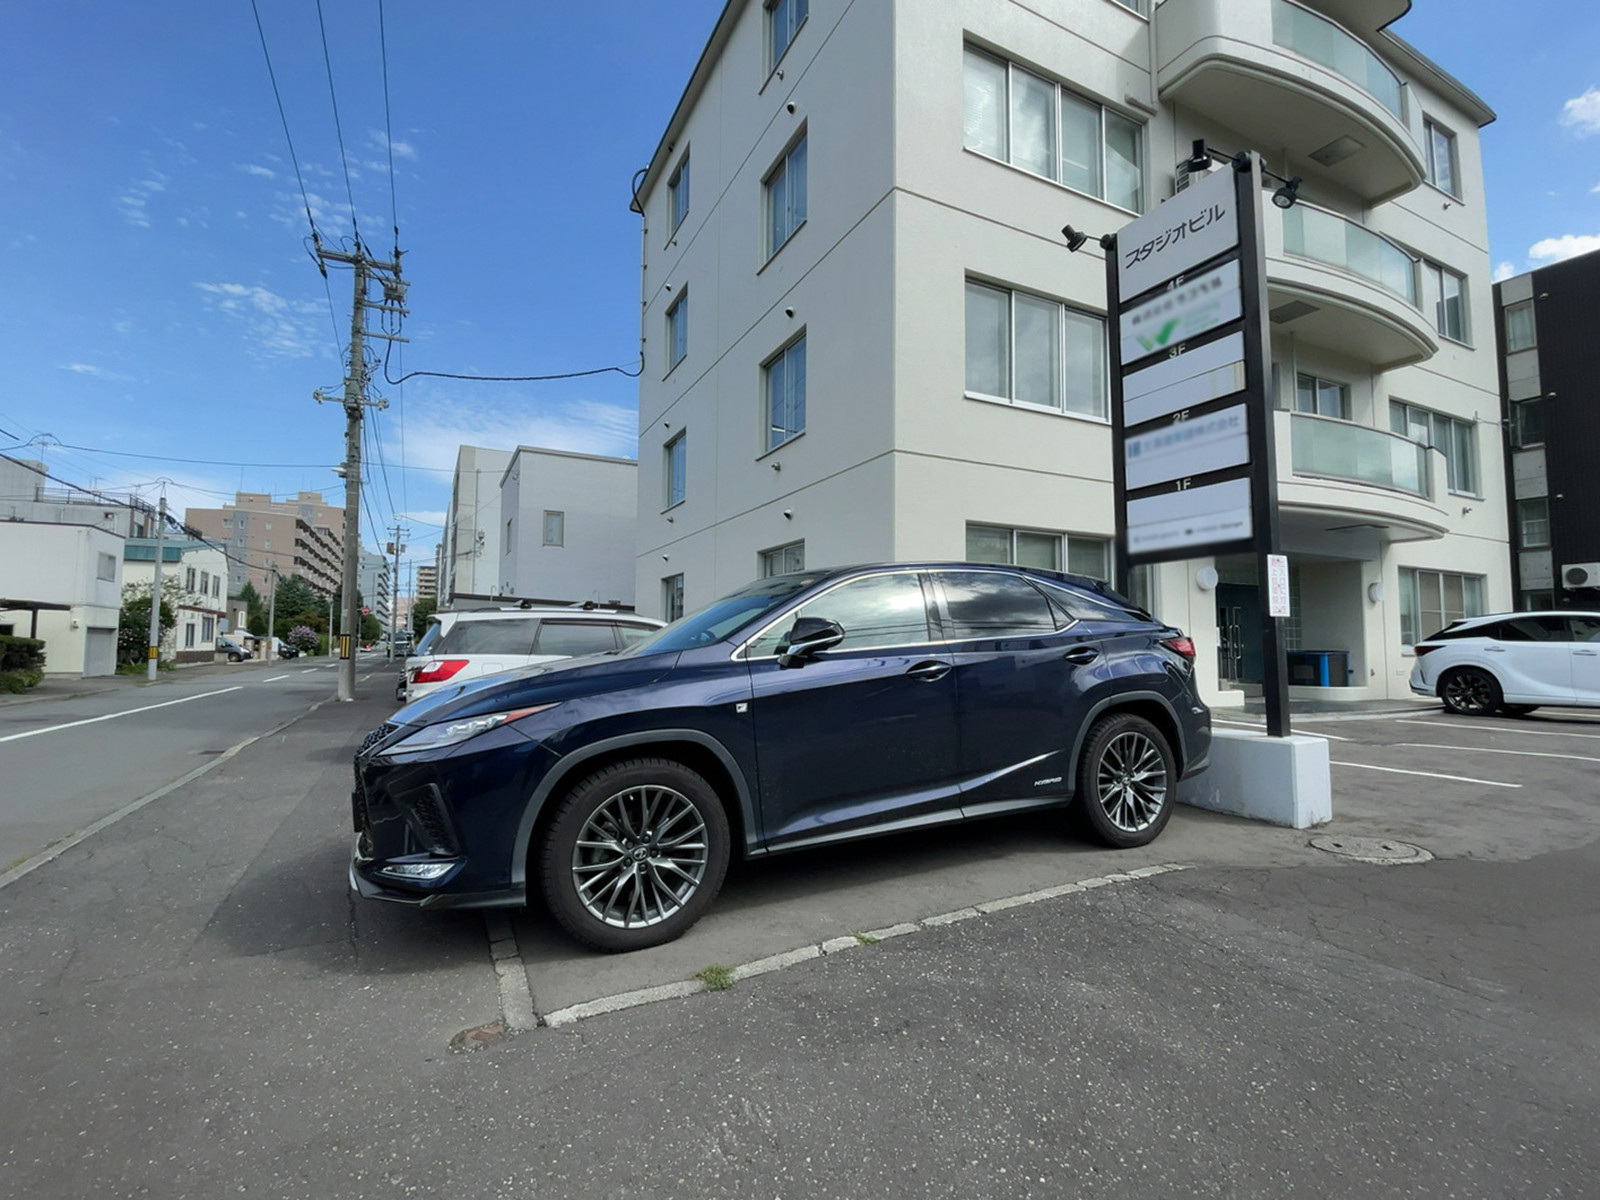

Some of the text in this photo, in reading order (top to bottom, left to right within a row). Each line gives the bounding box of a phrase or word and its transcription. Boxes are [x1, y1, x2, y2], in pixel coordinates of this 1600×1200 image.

[1125, 204, 1226, 269] スタジオビル
[1166, 274, 1185, 291] 4F
[1168, 343, 1187, 359] 3F
[1172, 410, 1190, 424] 2F
[1176, 477, 1192, 491] 1F
